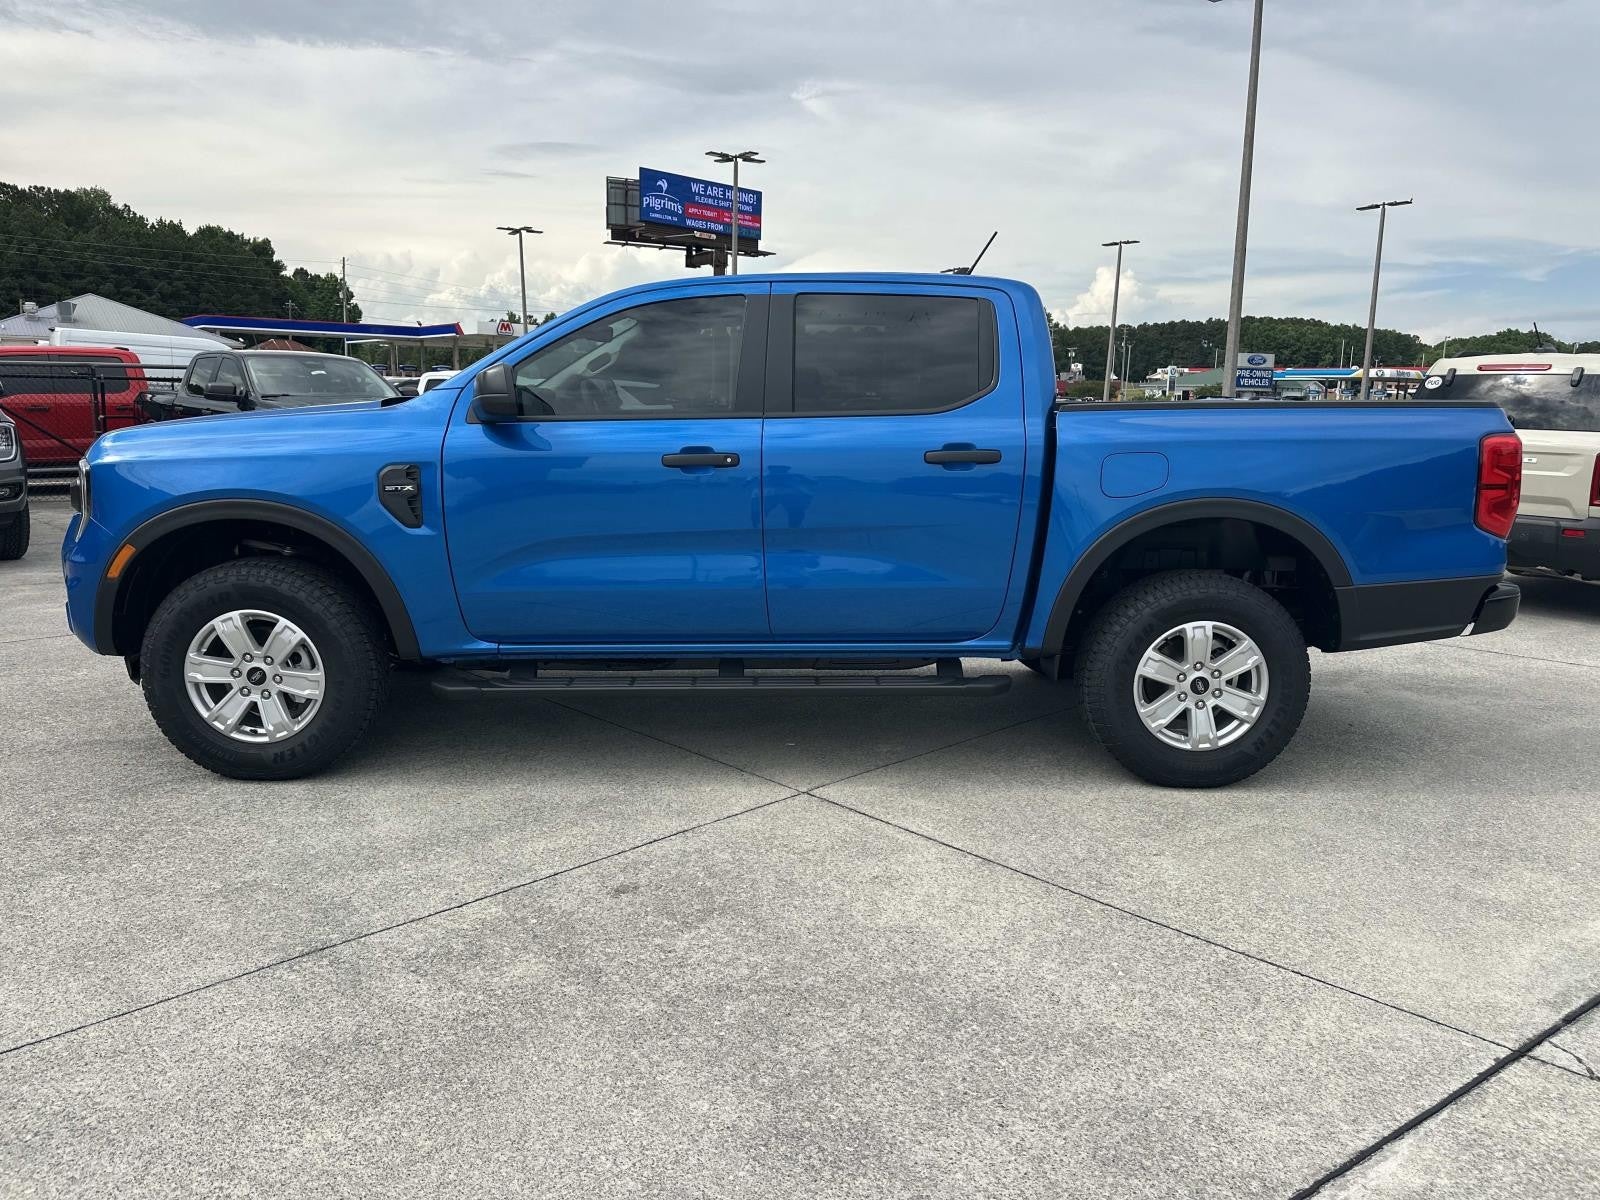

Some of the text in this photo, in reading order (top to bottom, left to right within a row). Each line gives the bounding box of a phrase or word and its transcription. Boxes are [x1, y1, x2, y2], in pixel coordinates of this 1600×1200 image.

[691, 182, 704, 194] WE
[707, 186, 723, 198] ARE
[643, 196, 684, 214] Pilgrim's
[695, 196, 718, 205] FLEXIBLE
[719, 200, 732, 208] SHIFT
[686, 218, 706, 228] WAGES
[708, 223, 723, 231] FROM
[1249, 355, 1265, 365] Ford
